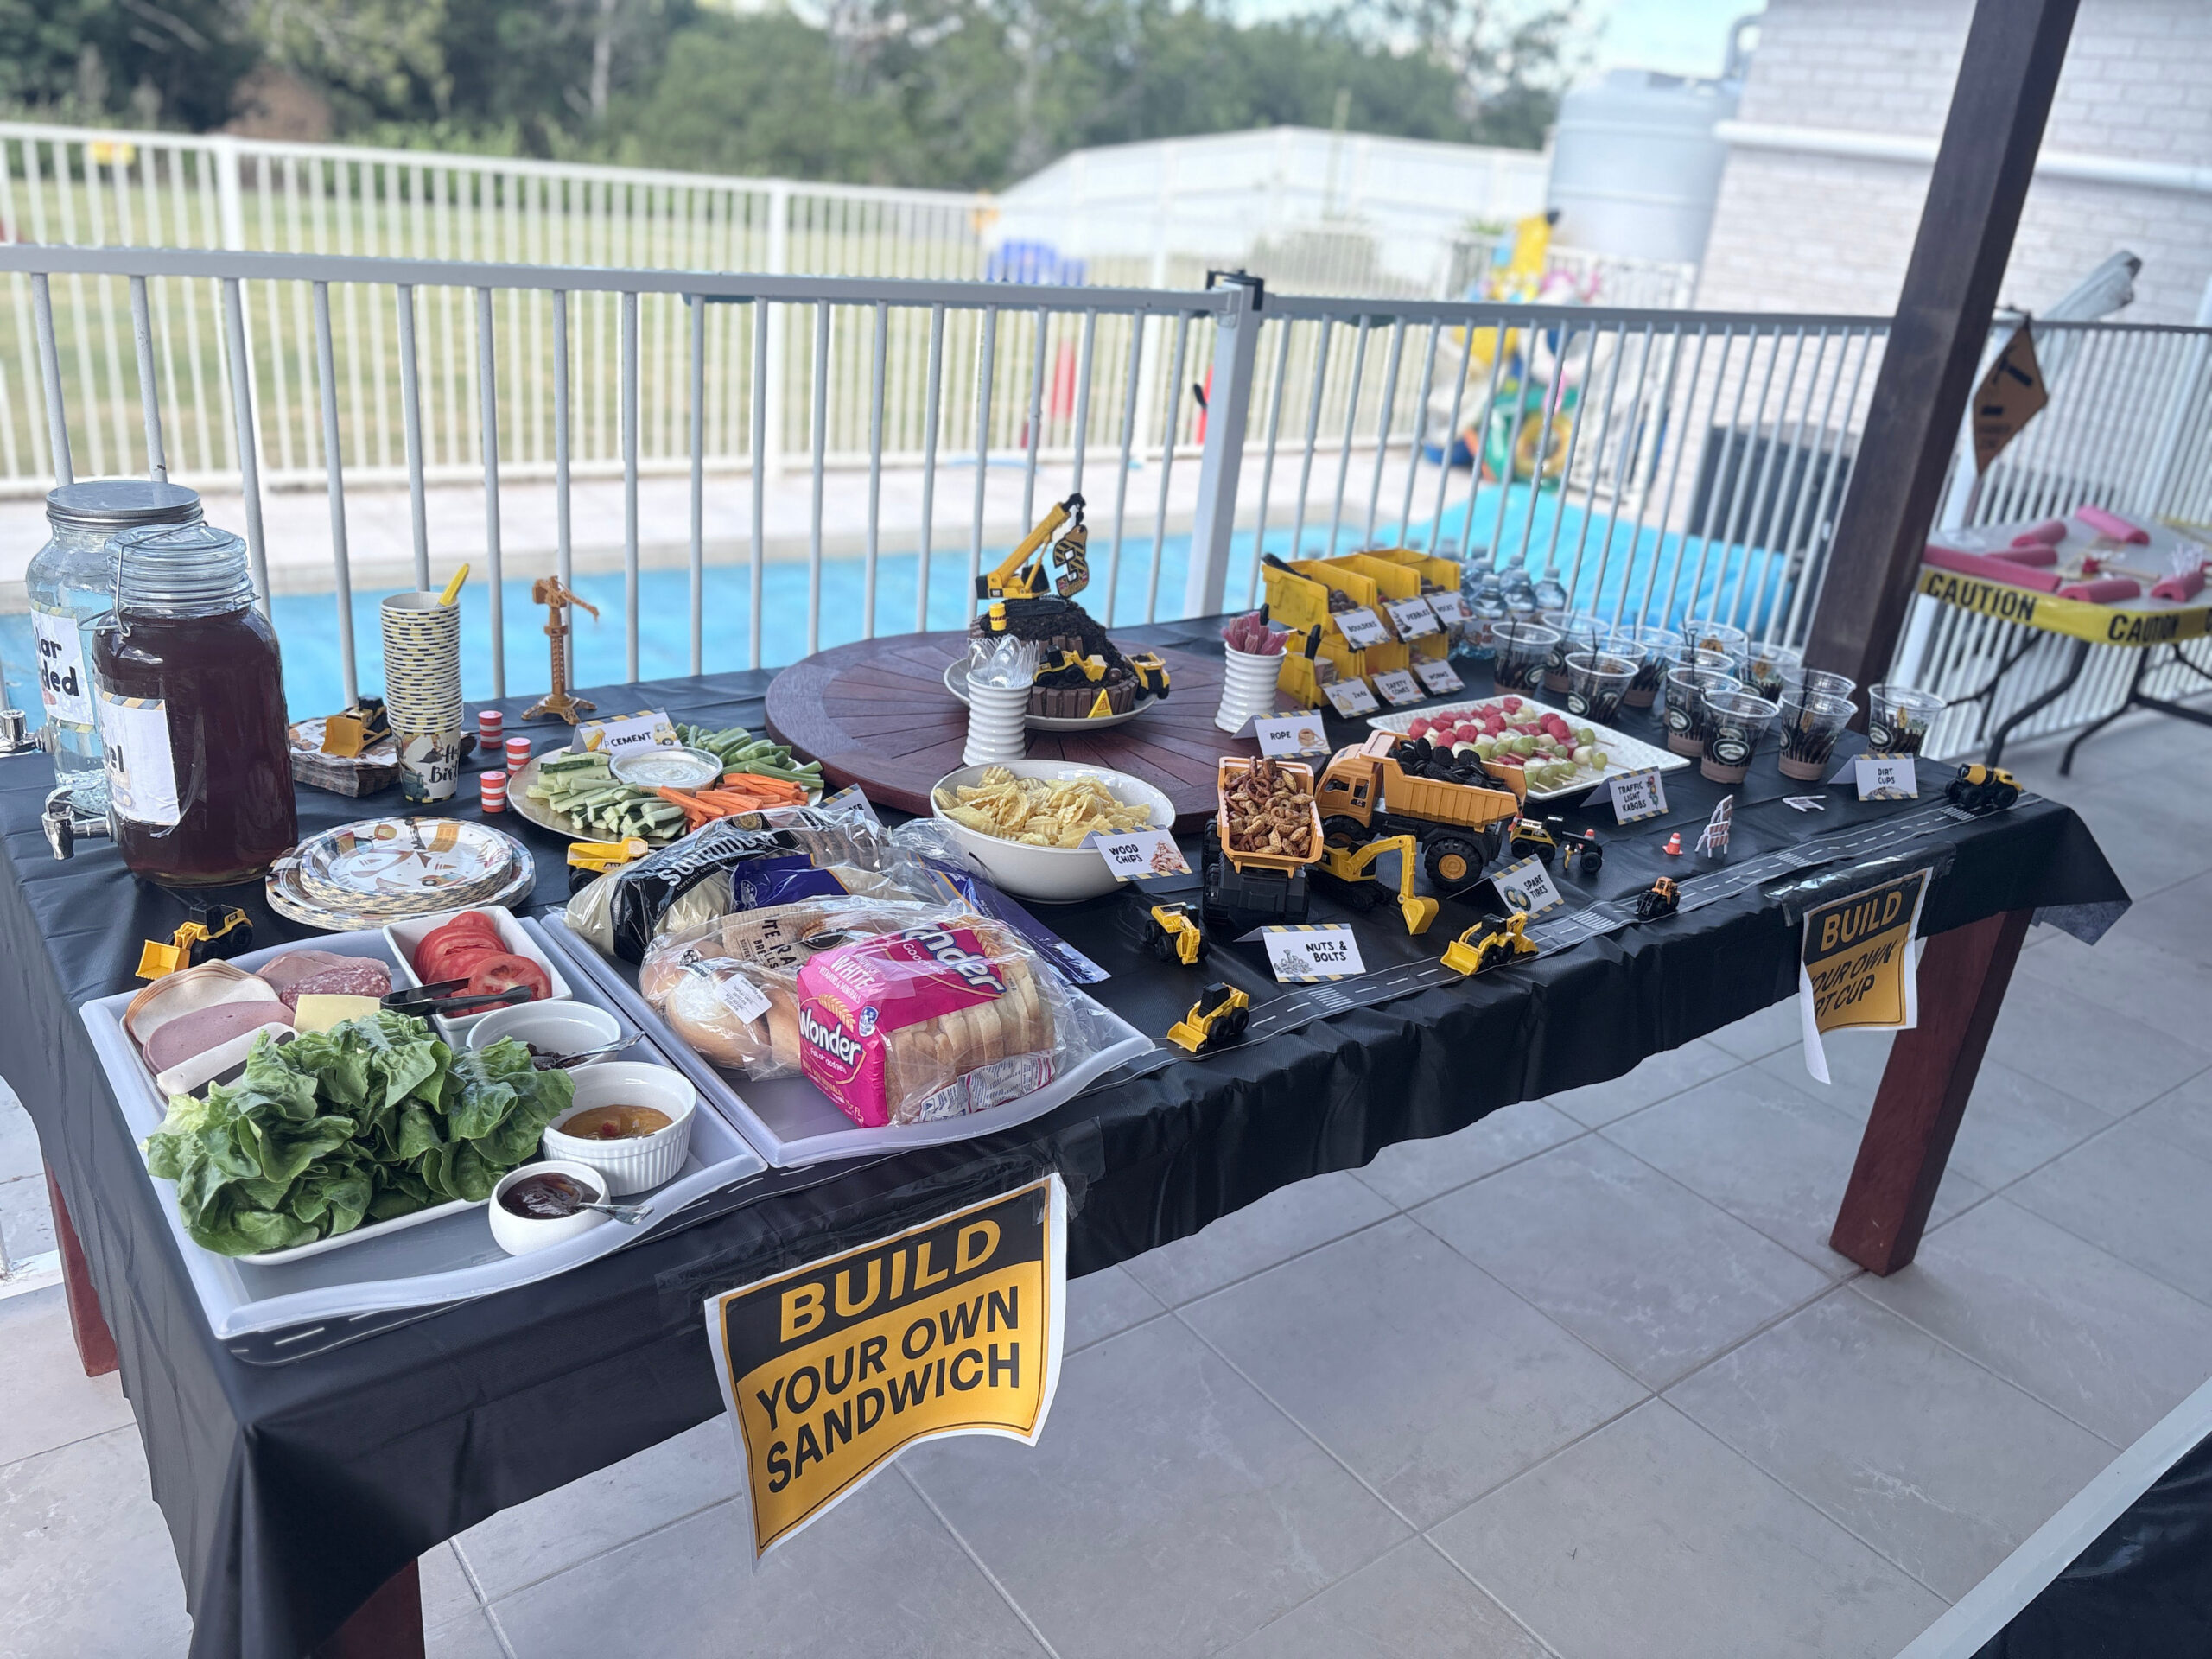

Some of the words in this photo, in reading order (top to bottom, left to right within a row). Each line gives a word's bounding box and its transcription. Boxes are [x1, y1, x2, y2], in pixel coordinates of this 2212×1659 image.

[1926, 573, 2037, 621] CAUTION
[1406, 608, 1431, 621] PEBBLES
[1346, 620, 1377, 633] BOULDERS
[1428, 671, 1449, 681] WORMS
[1385, 679, 1407, 690] SAFETY
[1391, 686, 1410, 696] CONES
[610, 731, 652, 747] CEMENT
[1270, 731, 1291, 740] ROPE
[1878, 776, 1895, 785] CUPS
[1618, 781, 1643, 795] TRAFFIC
[1624, 791, 1640, 803] LIGHT
[1622, 800, 1647, 813] KABOBS
[1109, 844, 1139, 855] WOOD
[1116, 854, 1143, 865] CHIPS
[1523, 874, 1544, 891] SPARE
[1529, 884, 1548, 899] TIRES
[1820, 890, 1902, 952] BUILD
[1306, 941, 1334, 952] NUTS
[1338, 940, 1348, 951] &
[1313, 951, 1346, 963] BOLTS
[830, 955, 876, 990] WHITE
[1811, 960, 1853, 995] OUR
[1850, 939, 1899, 980] OWN
[1834, 974, 1875, 1011] CUP
[799, 1006, 862, 1067] Wonder
[780, 1219, 1001, 1344] BUILD
[756, 1335, 888, 1432] YOUR
[901, 1285, 1019, 1360] OWN
[766, 1342, 1020, 1494] SANDWICH
